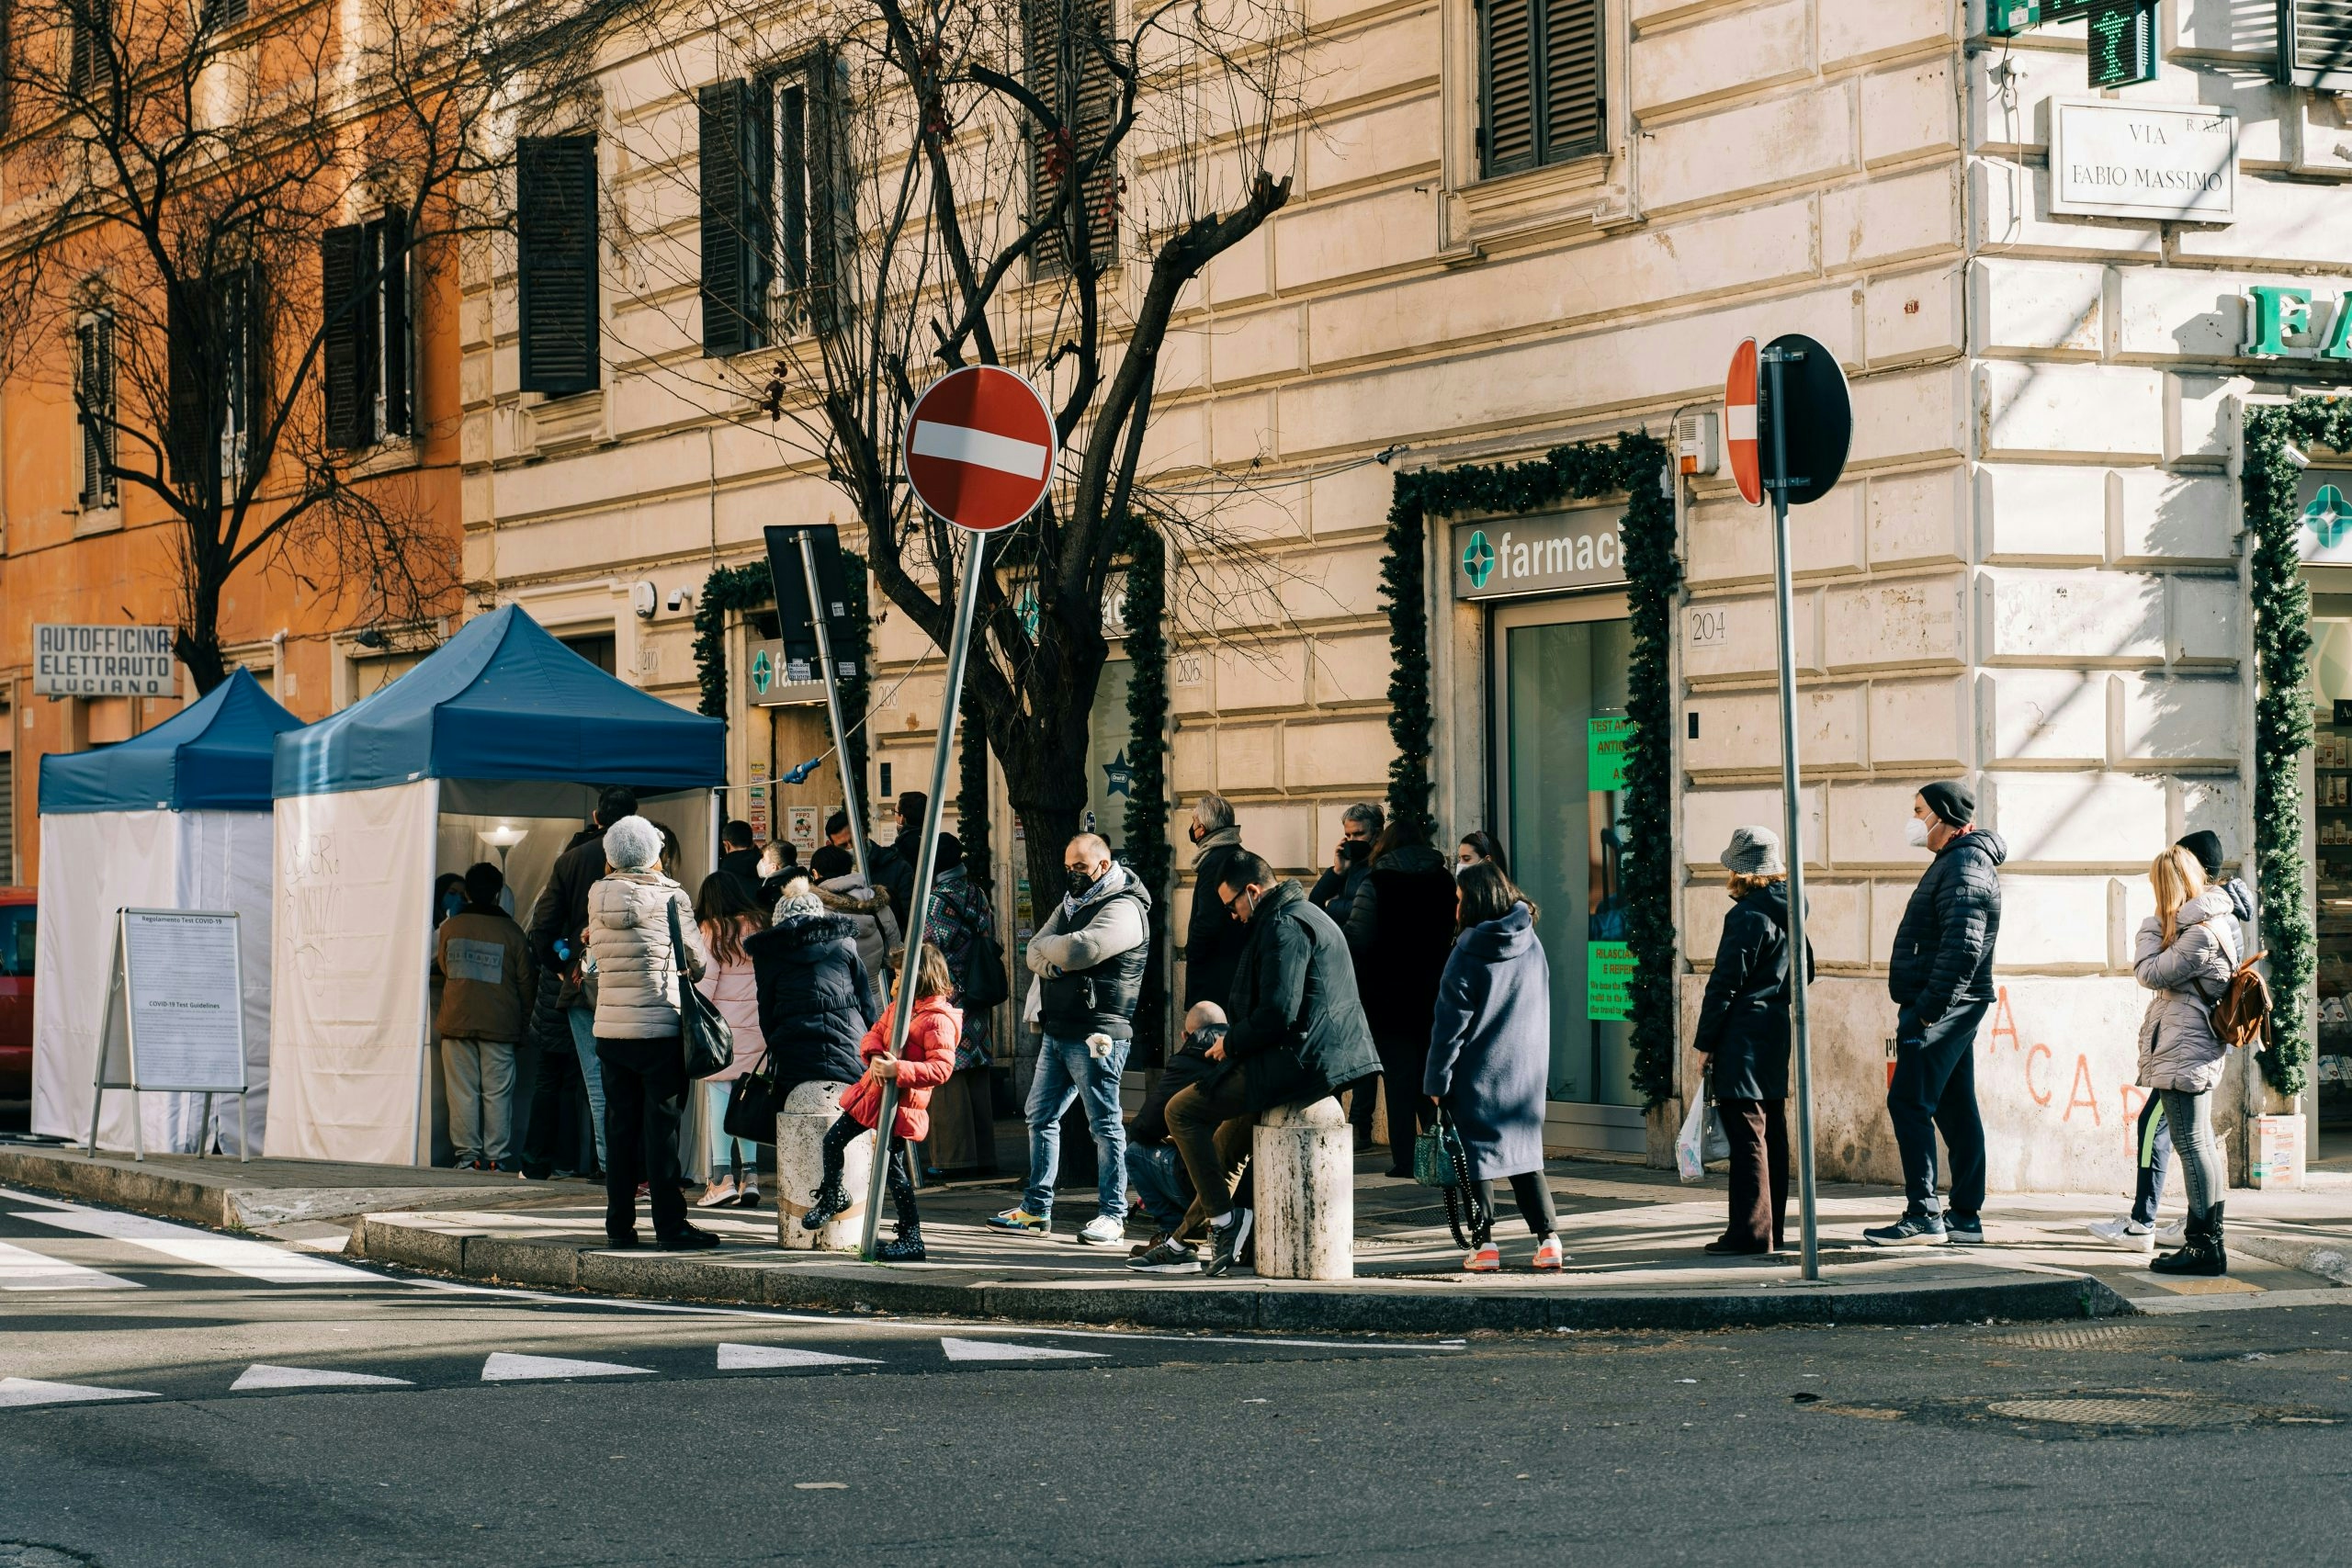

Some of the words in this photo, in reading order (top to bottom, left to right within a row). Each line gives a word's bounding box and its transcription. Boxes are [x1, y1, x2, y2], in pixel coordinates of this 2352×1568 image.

[2129, 124, 2166, 145] VIA
[2073, 164, 2127, 186] FABIO
[2134, 168, 2222, 192] MASSIMO
[1691, 611, 1725, 641] 204
[40, 626, 170, 654] AUTOFFICINA
[40, 655, 169, 677] ELETTRAUTO
[642, 651, 659, 671] 210
[51, 678, 159, 694] LUCIANO
[1591, 719, 1612, 732] TEST
[141, 916, 181, 924] Regolamento
[189, 1001, 220, 1010] Guidelines
